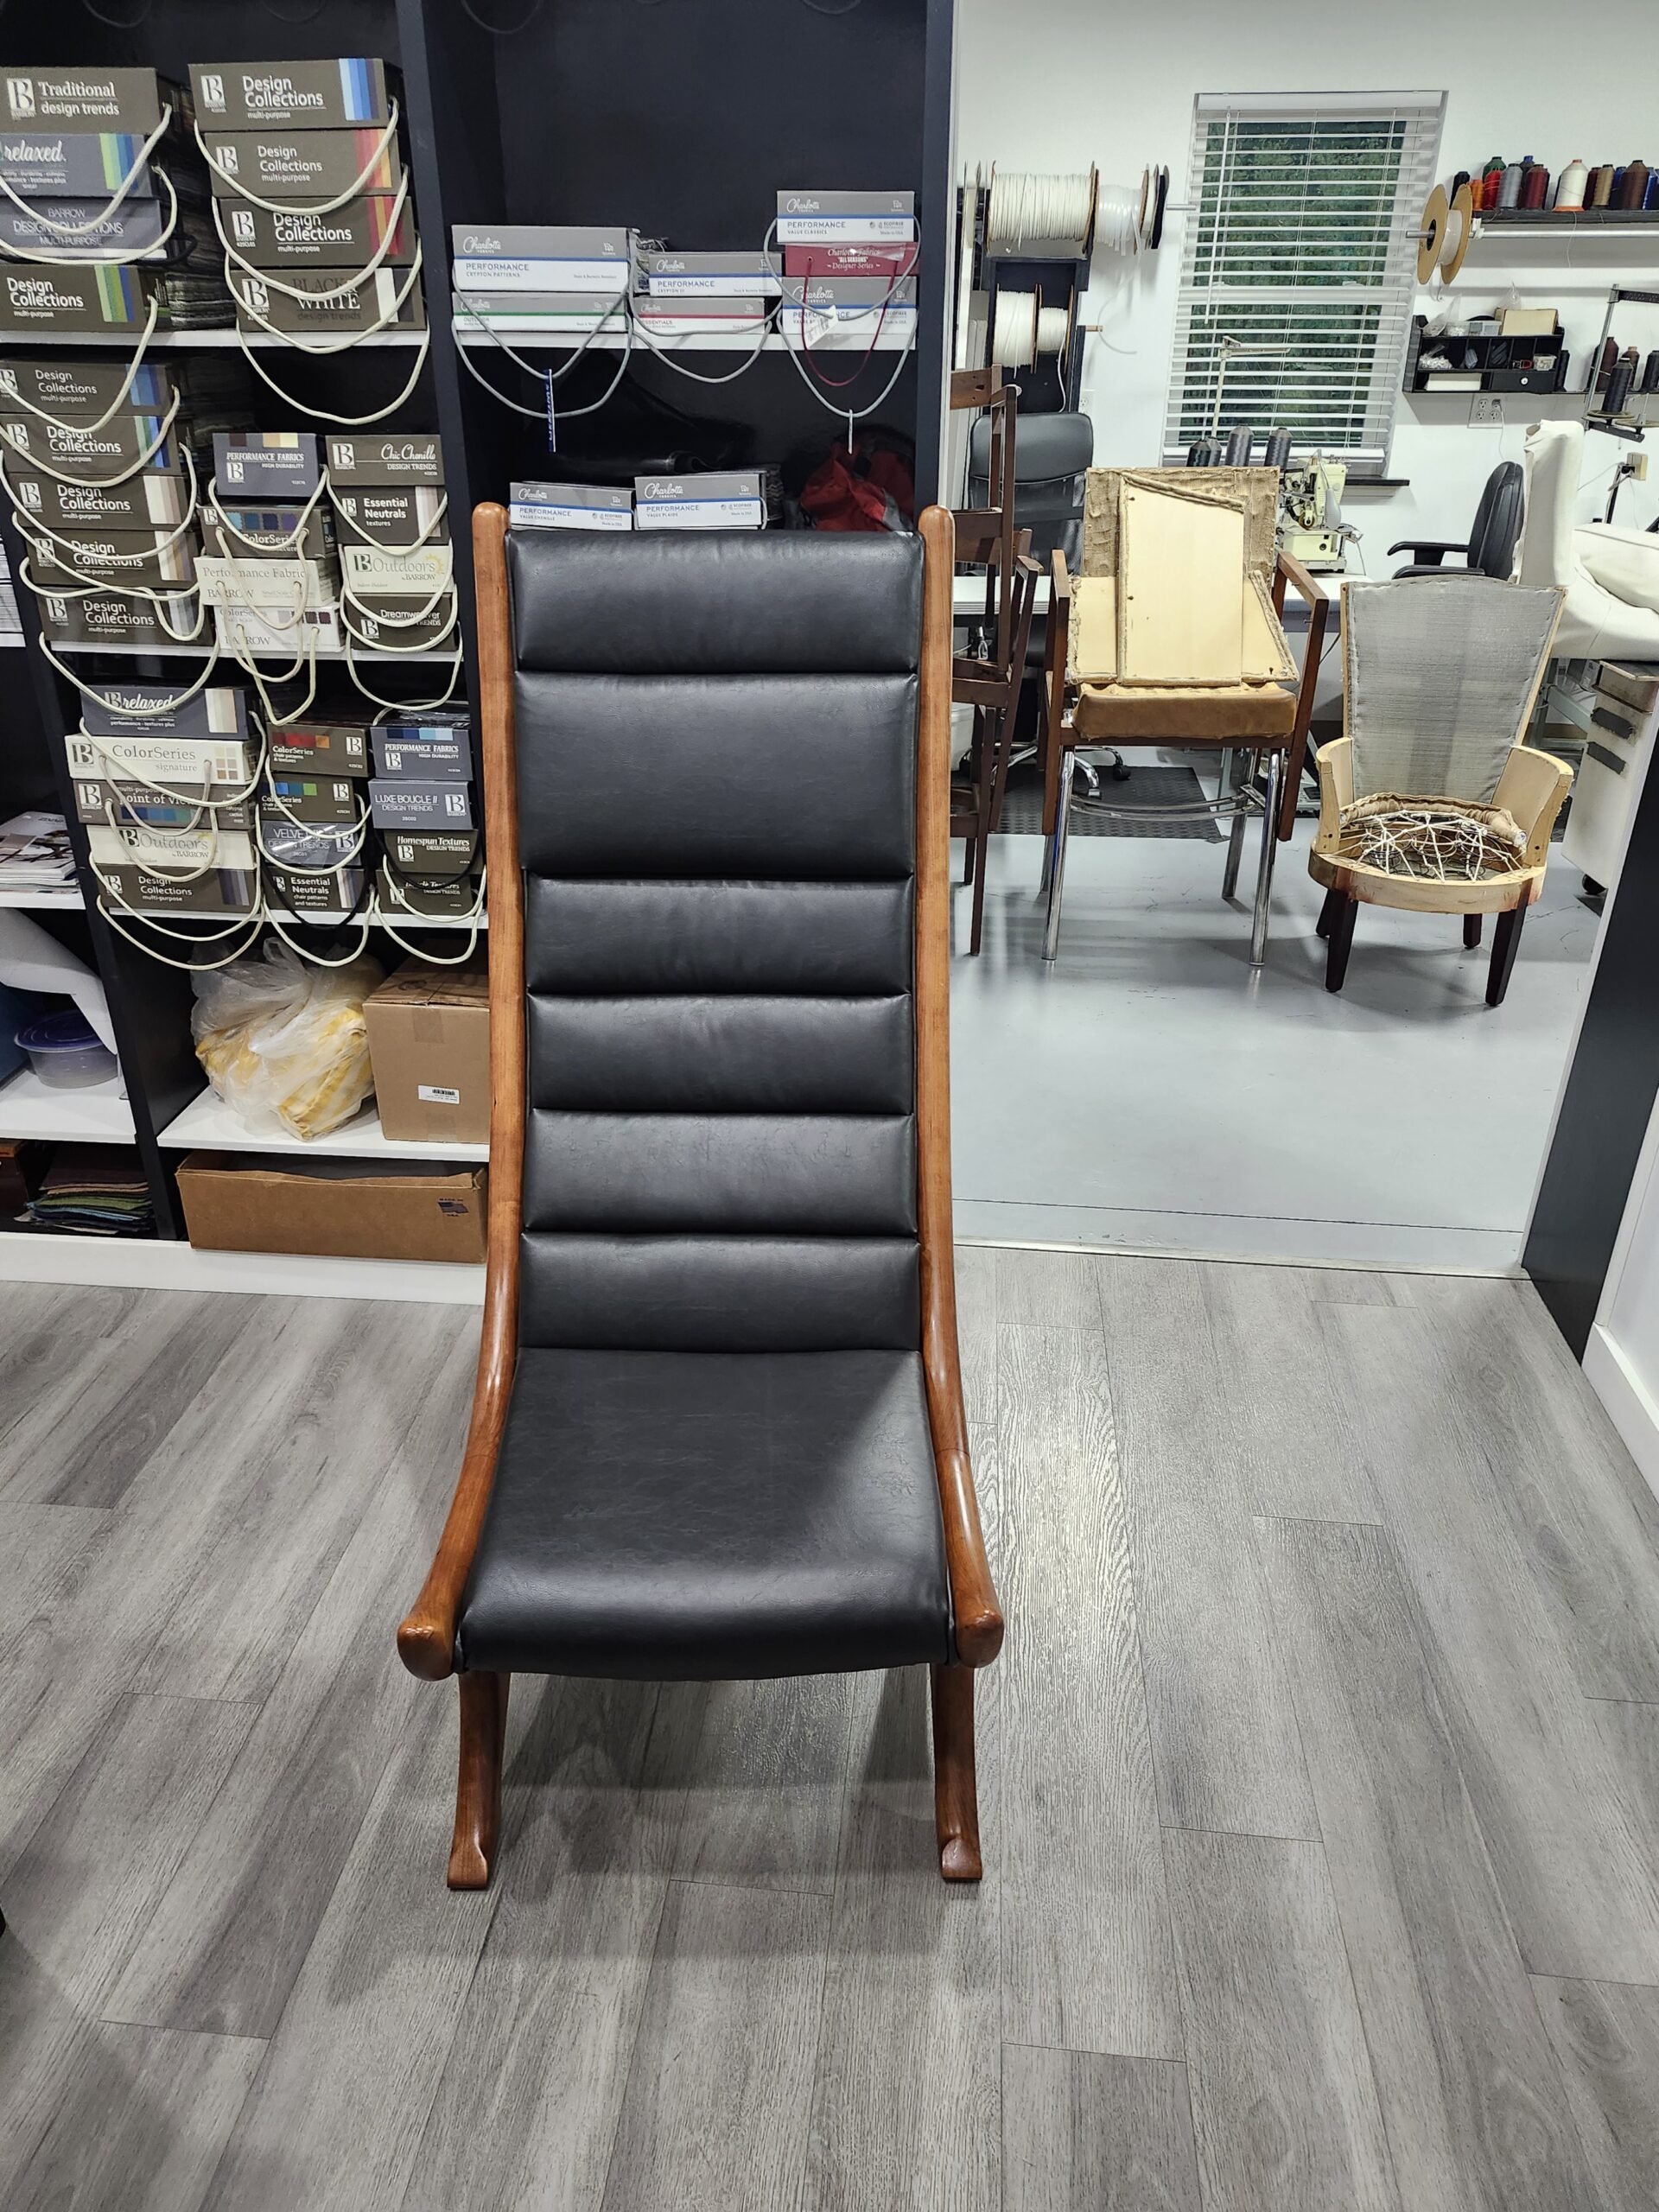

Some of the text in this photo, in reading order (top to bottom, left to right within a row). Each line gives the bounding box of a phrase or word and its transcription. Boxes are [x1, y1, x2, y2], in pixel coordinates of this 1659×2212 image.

[38, 81, 116, 98] Traditional
[243, 75, 292, 94] Design
[245, 92, 323, 108] Collections
[41, 102, 79, 117] design
[82, 102, 119, 116] trends
[247, 111, 291, 119] multi-purpose
[258, 145, 297, 162] Design
[260, 160, 322, 173] Collections
[262, 174, 310, 182] multi-purpose
[787, 198, 820, 213] Charlotte
[48, 207, 86, 218] BARROW
[273, 213, 321, 232] Design
[276, 226, 353, 242] Collections
[463, 236, 501, 253] Charlotte
[828, 248, 856, 257] Charlo
[7, 277, 53, 293] Design
[10, 292, 84, 308] Collections
[296, 293, 361, 309] WHITE
[331, 312, 361, 321] trends
[35, 370, 72, 382] Design
[38, 383, 97, 394] Collections
[47, 426, 93, 442] Design
[49, 440, 122, 453] Collections
[381, 443, 401, 460] Chic
[226, 452, 304, 461] PERFORMANCE FABRICS
[57, 485, 102, 499] Design
[645, 483, 683, 499] Charlotte
[60, 497, 130, 511] Collections
[364, 498, 408, 507] Essential
[365, 510, 406, 518] Neutrals
[520, 507, 571, 517] PERFORMANCE
[71, 540, 115, 556] Design
[73, 551, 143, 567] Collections
[373, 555, 435, 572] Outdoors
[203, 567, 306, 578] Perfoance Fabric
[83, 601, 126, 614] Design
[380, 609, 441, 619] Dreamwver
[86, 612, 155, 626] Collections
[225, 636, 270, 645] AROW
[112, 745, 196, 760] ColorSeries
[273, 746, 314, 755] ColorSeries
[156, 794, 165, 804] of
[262, 795, 302, 804] ColSeries
[375, 795, 397, 804] LUXE
[397, 795, 431, 804] BOUCLE
[273, 828, 308, 838] VELVE
[141, 833, 208, 849] Outdoors
[397, 836, 470, 846] Homespun Textures
[138, 876, 171, 886] Design
[290, 877, 330, 886] Essential
[141, 886, 192, 895] Collections
[292, 886, 329, 894] Neutrals
